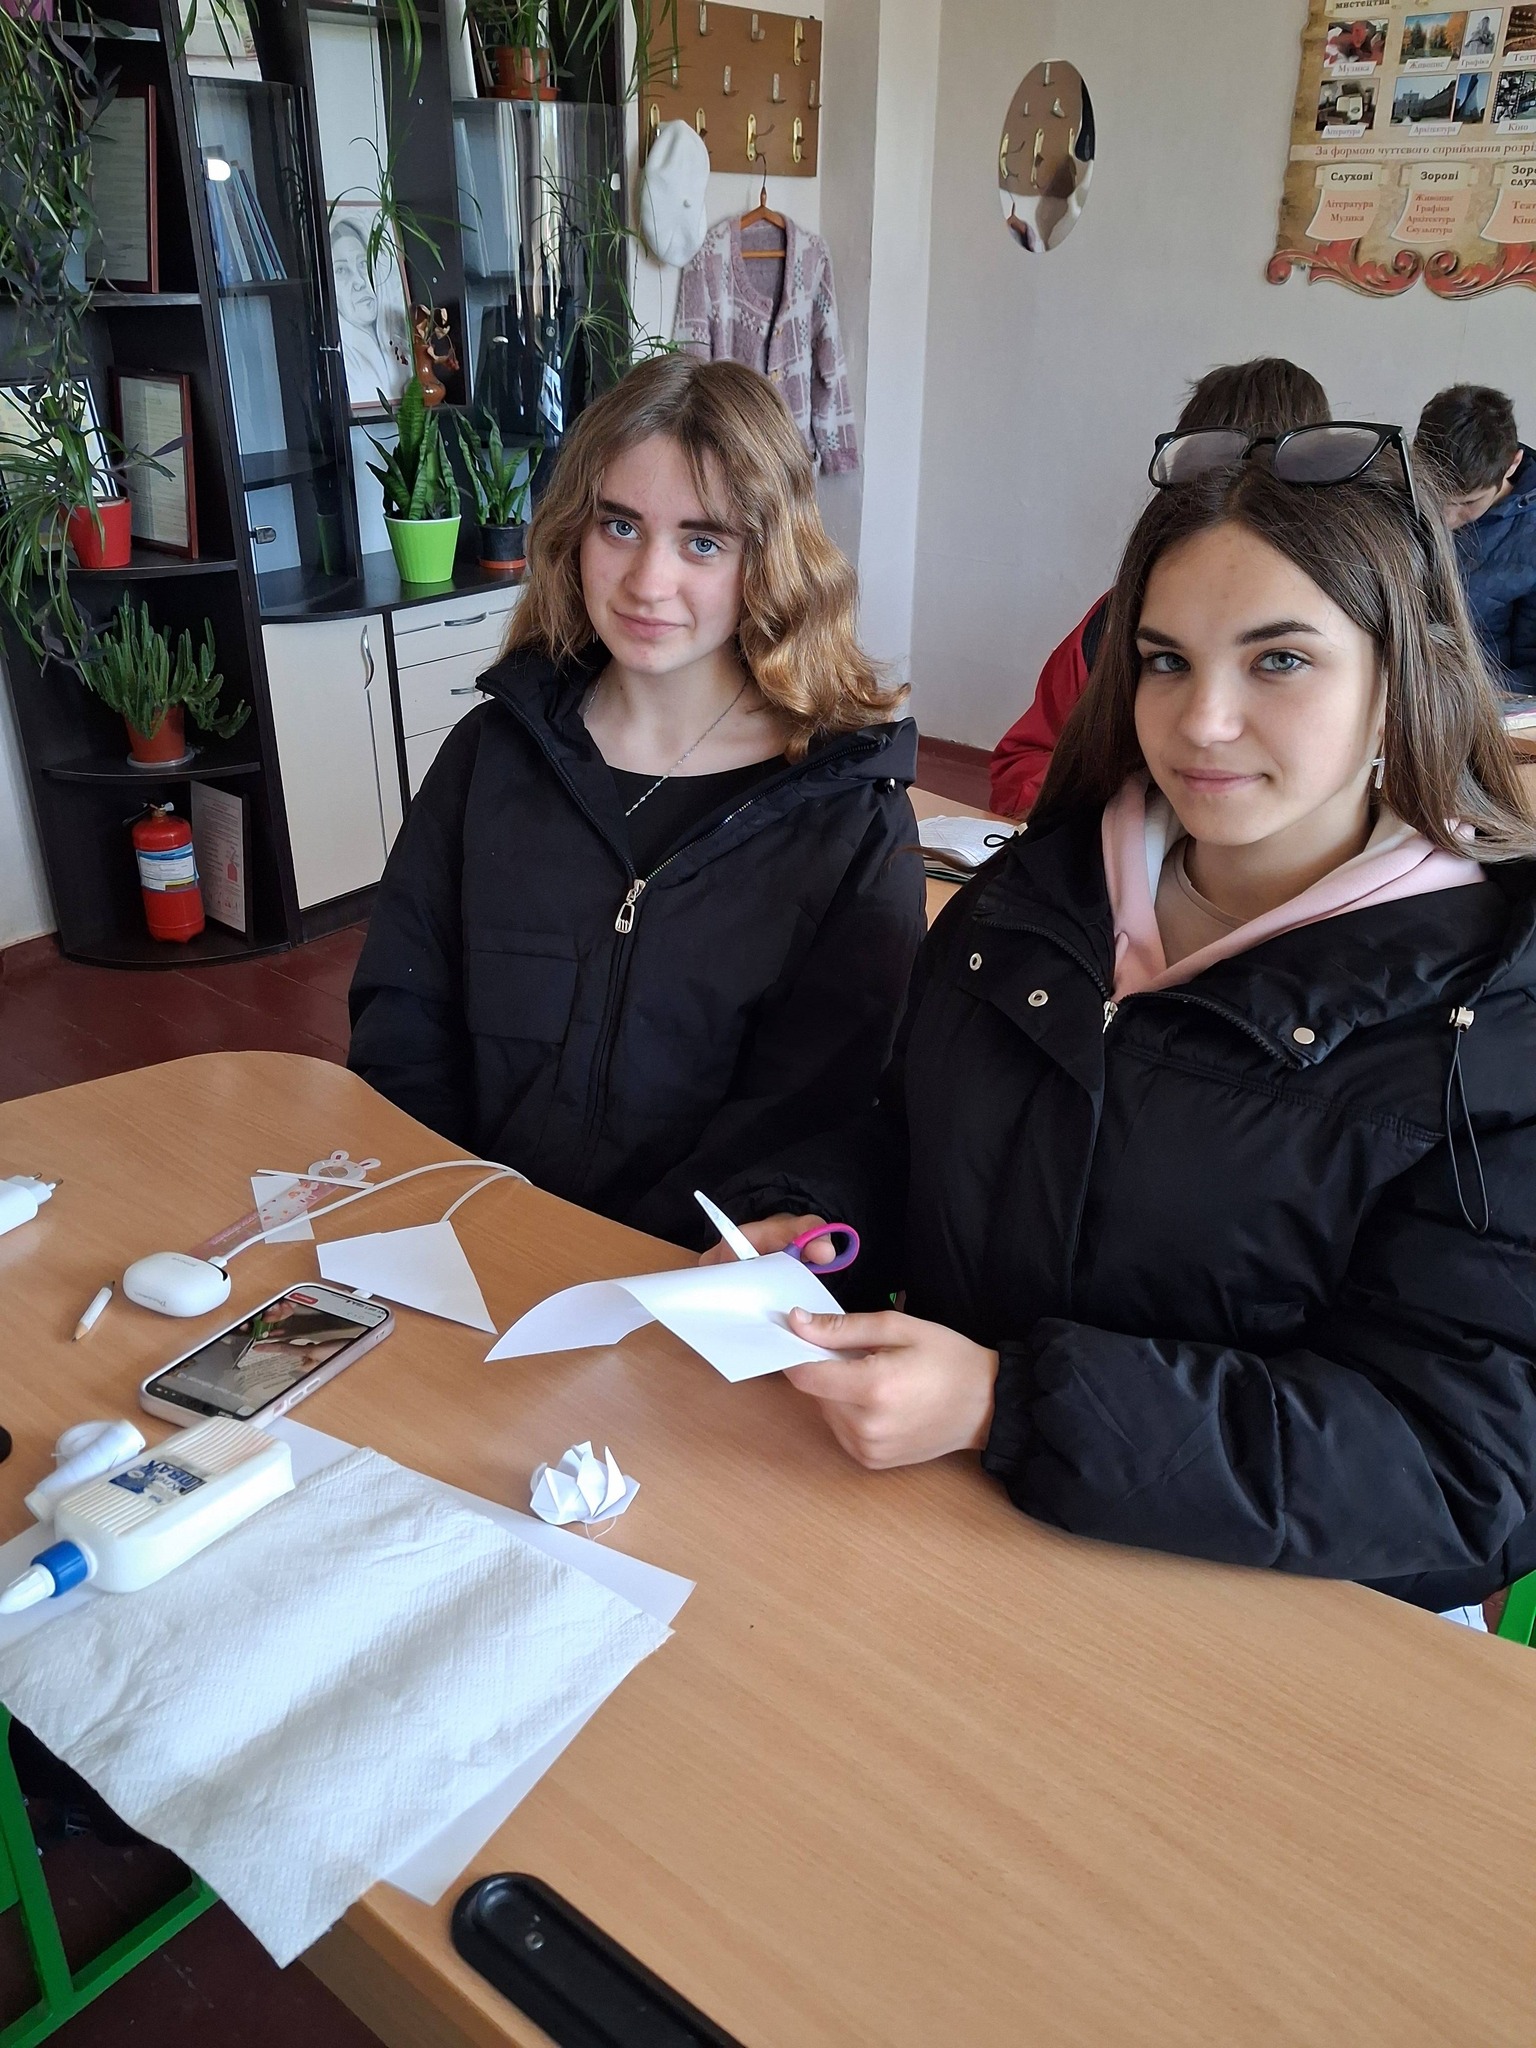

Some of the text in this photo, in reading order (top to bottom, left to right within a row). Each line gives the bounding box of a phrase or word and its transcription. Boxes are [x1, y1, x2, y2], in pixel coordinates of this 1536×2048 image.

[1338, 64, 1370, 74] Музика
[1508, 123, 1529, 132] Кіно
[1315, 145, 1328, 156] За
[1331, 145, 1375, 158] формою
[1432, 143, 1500, 156] сприймання
[1330, 171, 1374, 184] Слухові
[1420, 171, 1459, 183] Зорові
[1415, 193, 1454, 202] Живопис
[1325, 200, 1374, 210] Література
[1416, 204, 1450, 215] Графіка
[1330, 213, 1364, 223] Музика
[1407, 215, 1456, 226] Архітектура
[1406, 225, 1453, 236] Скульптура
